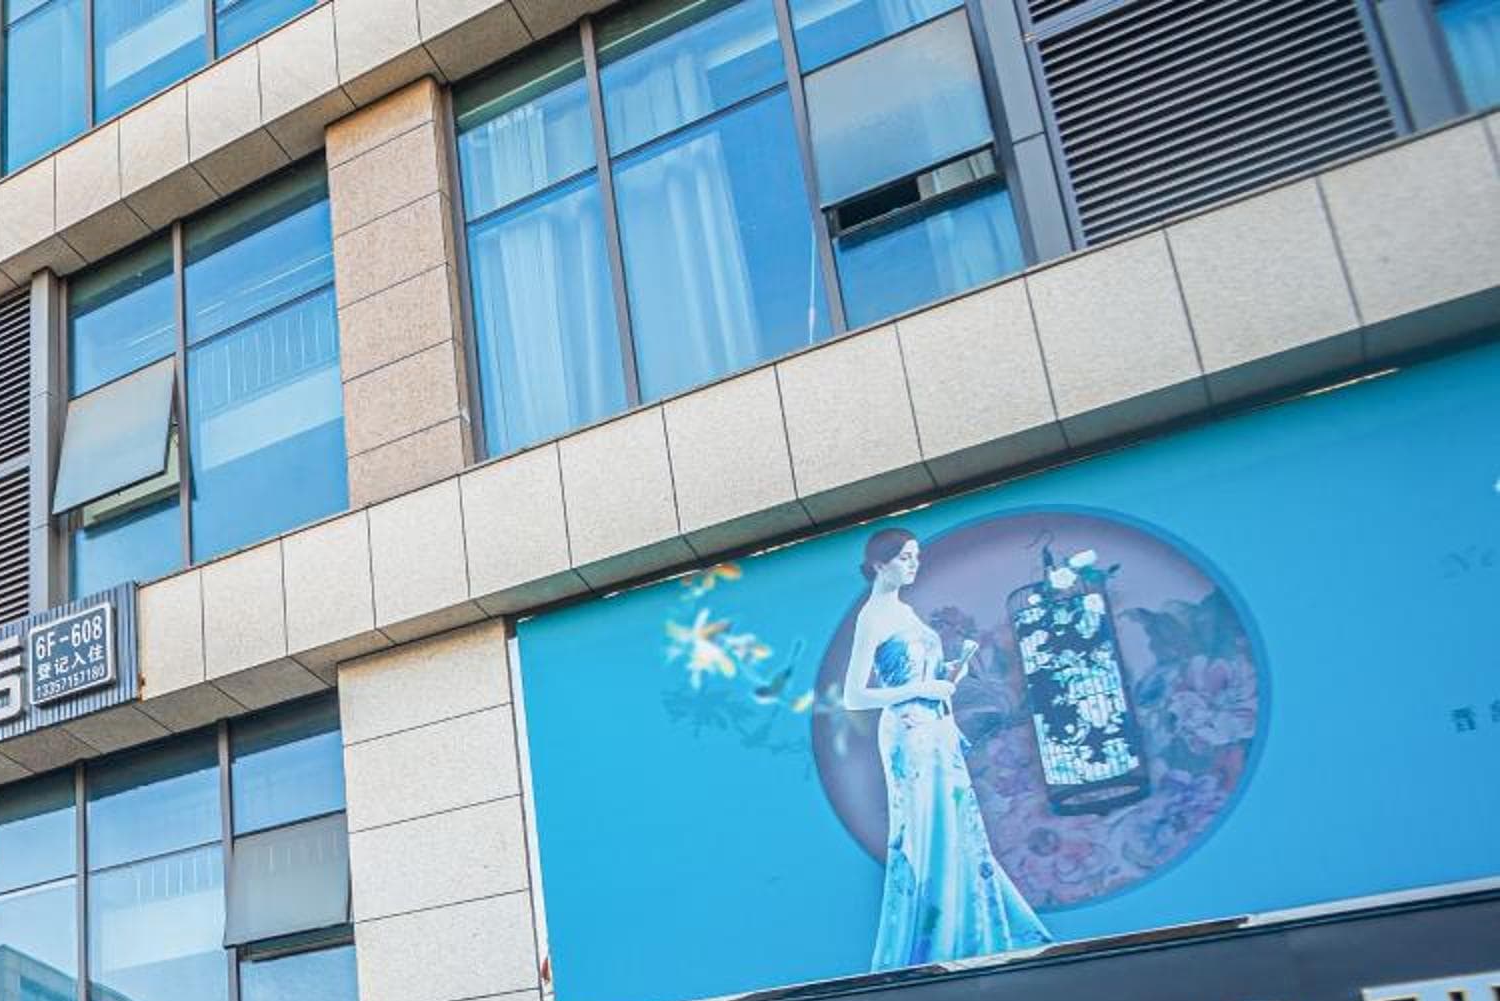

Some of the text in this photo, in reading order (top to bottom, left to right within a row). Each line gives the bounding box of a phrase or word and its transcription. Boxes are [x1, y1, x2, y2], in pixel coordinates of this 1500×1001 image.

[35, 615, 103, 660] 6F-608
[36, 643, 105, 681] 登记入住
[36, 664, 105, 699] 13357157180
